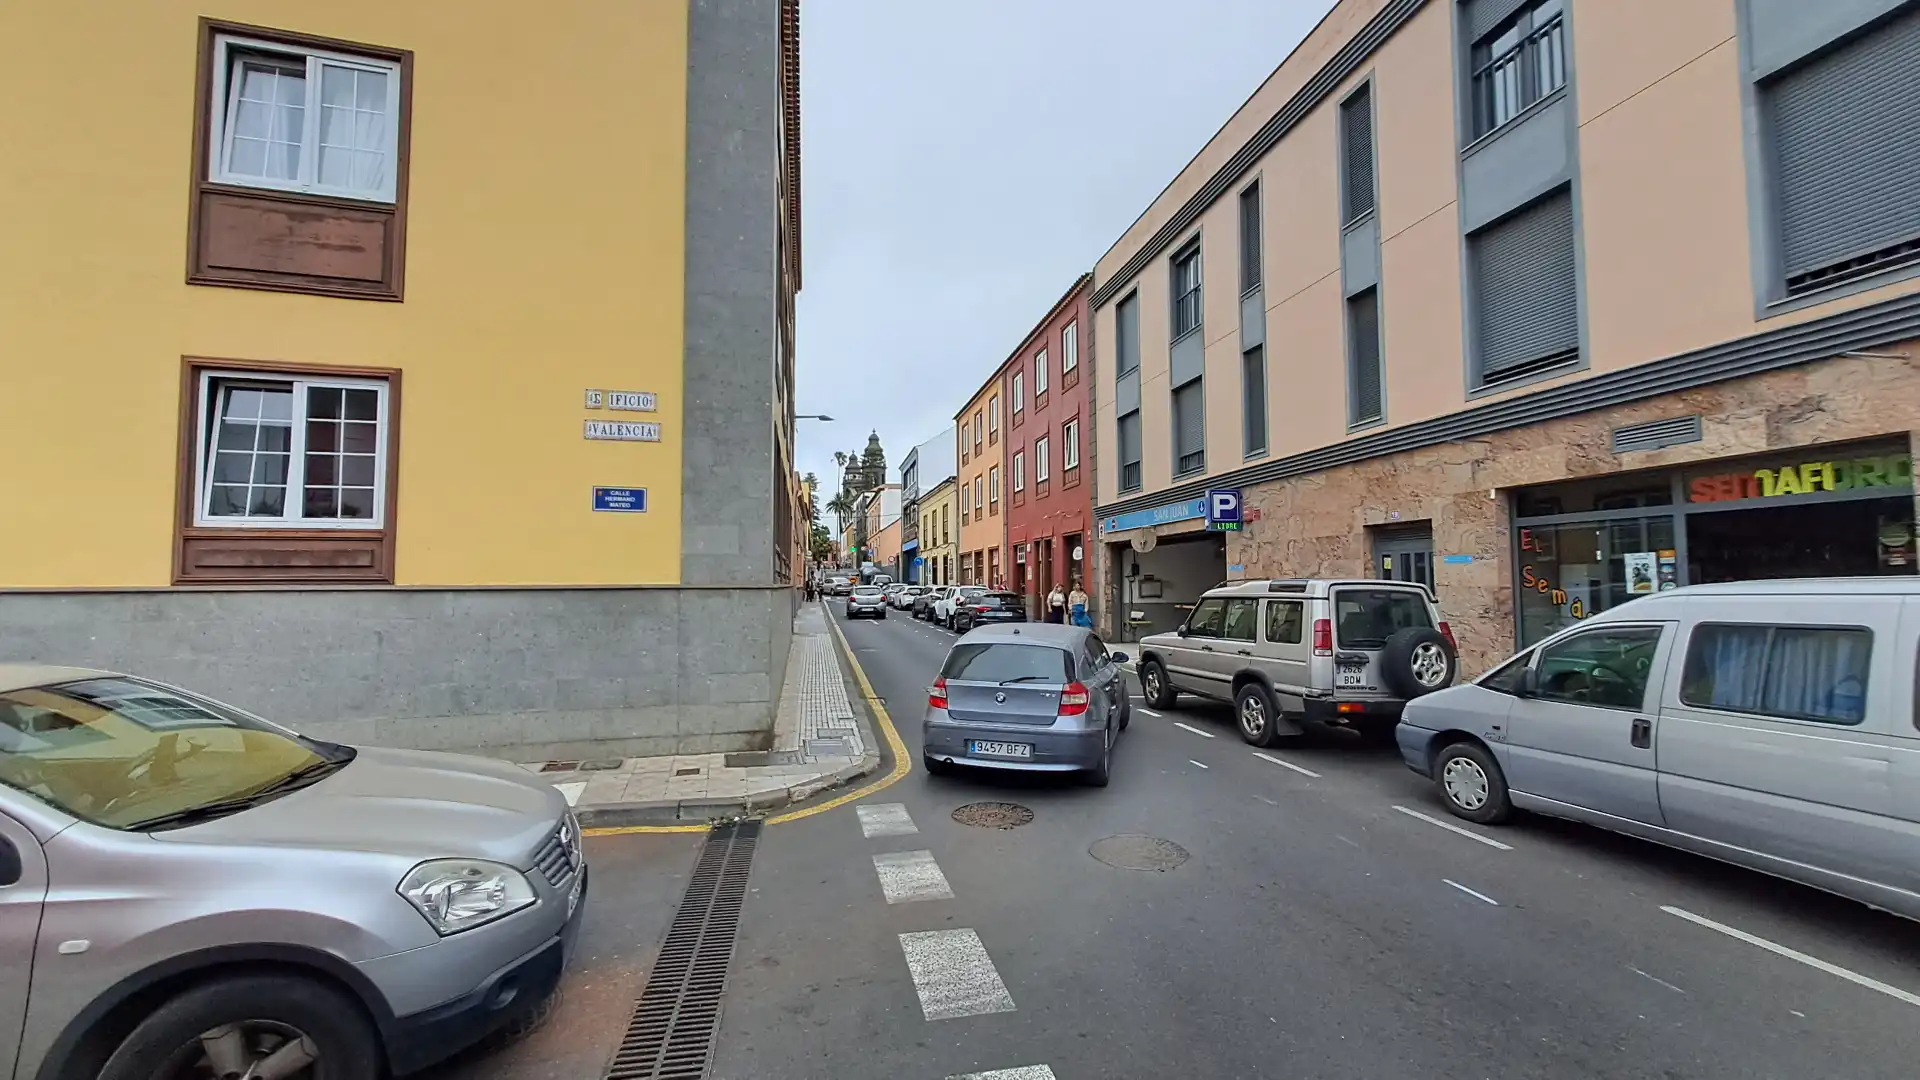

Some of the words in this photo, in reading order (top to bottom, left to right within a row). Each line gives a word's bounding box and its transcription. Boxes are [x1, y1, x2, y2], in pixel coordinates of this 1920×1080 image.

[592, 424, 654, 437] VALENCIA
[1153, 507, 1169, 521] SAN
[1169, 503, 1189, 520] JUAN
[1213, 494, 1237, 519] P
[977, 741, 1003, 753] 9457
[1006, 744, 1027, 756] BFZ
